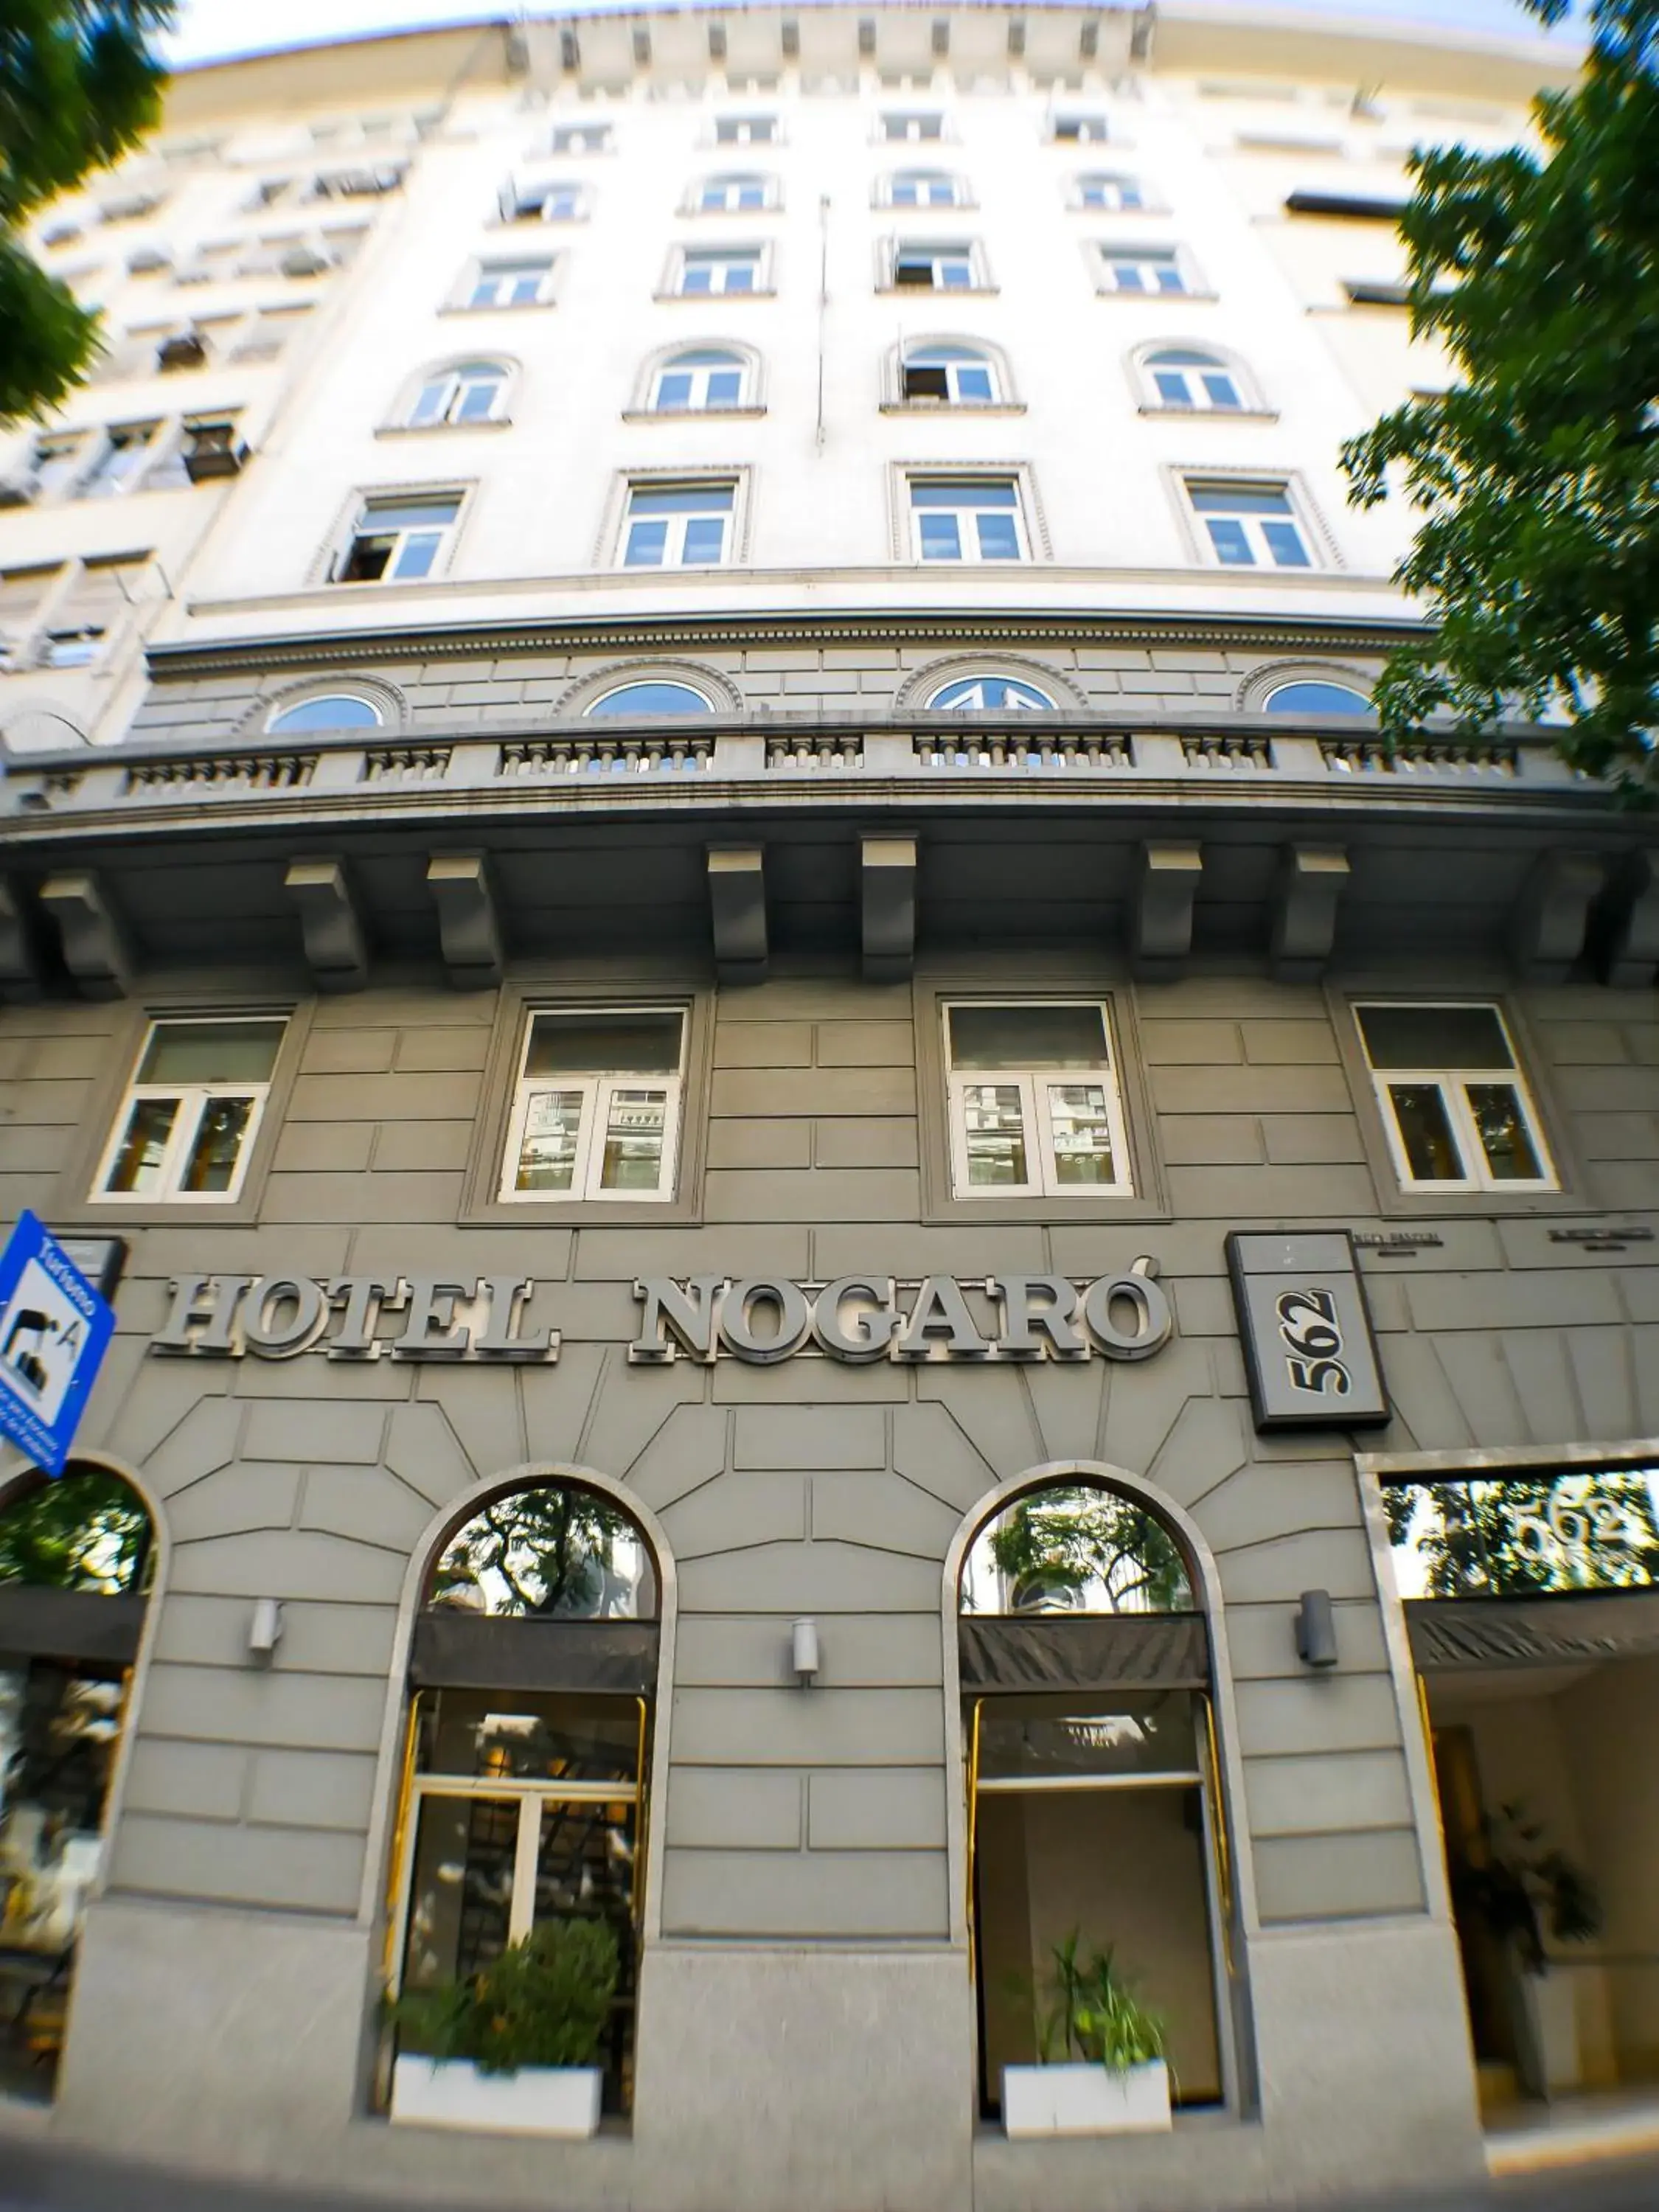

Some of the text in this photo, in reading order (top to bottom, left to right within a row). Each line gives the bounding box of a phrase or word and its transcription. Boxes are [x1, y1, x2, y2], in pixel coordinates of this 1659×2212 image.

[39, 1236, 96, 1316] Turismo
[150, 1255, 1172, 1364] HOTEL NOGARÓ
[1276, 1289, 1352, 1397] 562
[1513, 1489, 1625, 1562] 562
